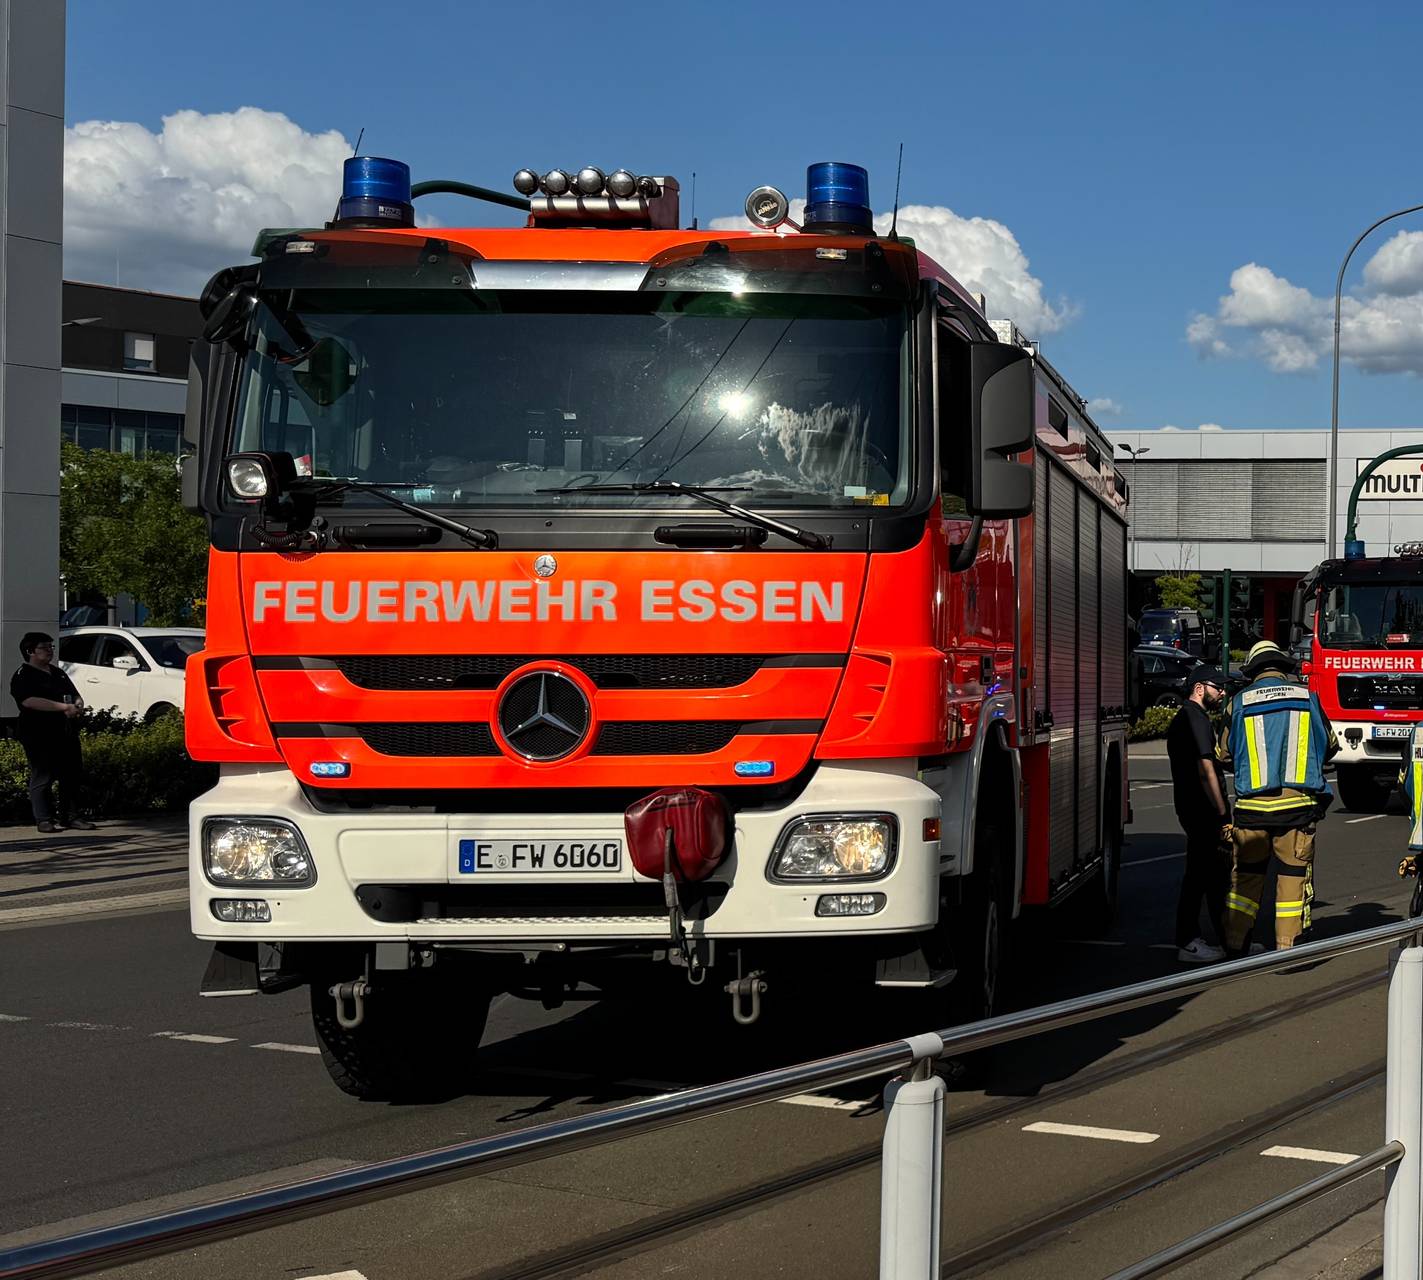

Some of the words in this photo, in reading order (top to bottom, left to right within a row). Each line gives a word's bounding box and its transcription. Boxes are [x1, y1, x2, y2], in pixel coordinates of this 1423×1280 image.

[252, 580, 617, 623] FEUERWEHR
[640, 581, 844, 622] ESSEN
[1324, 657, 1415, 670] FEUERWEHR
[464, 859, 471, 867] D
[477, 844, 493, 869] E
[511, 844, 546, 869] FW
[553, 843, 619, 868] 6060
